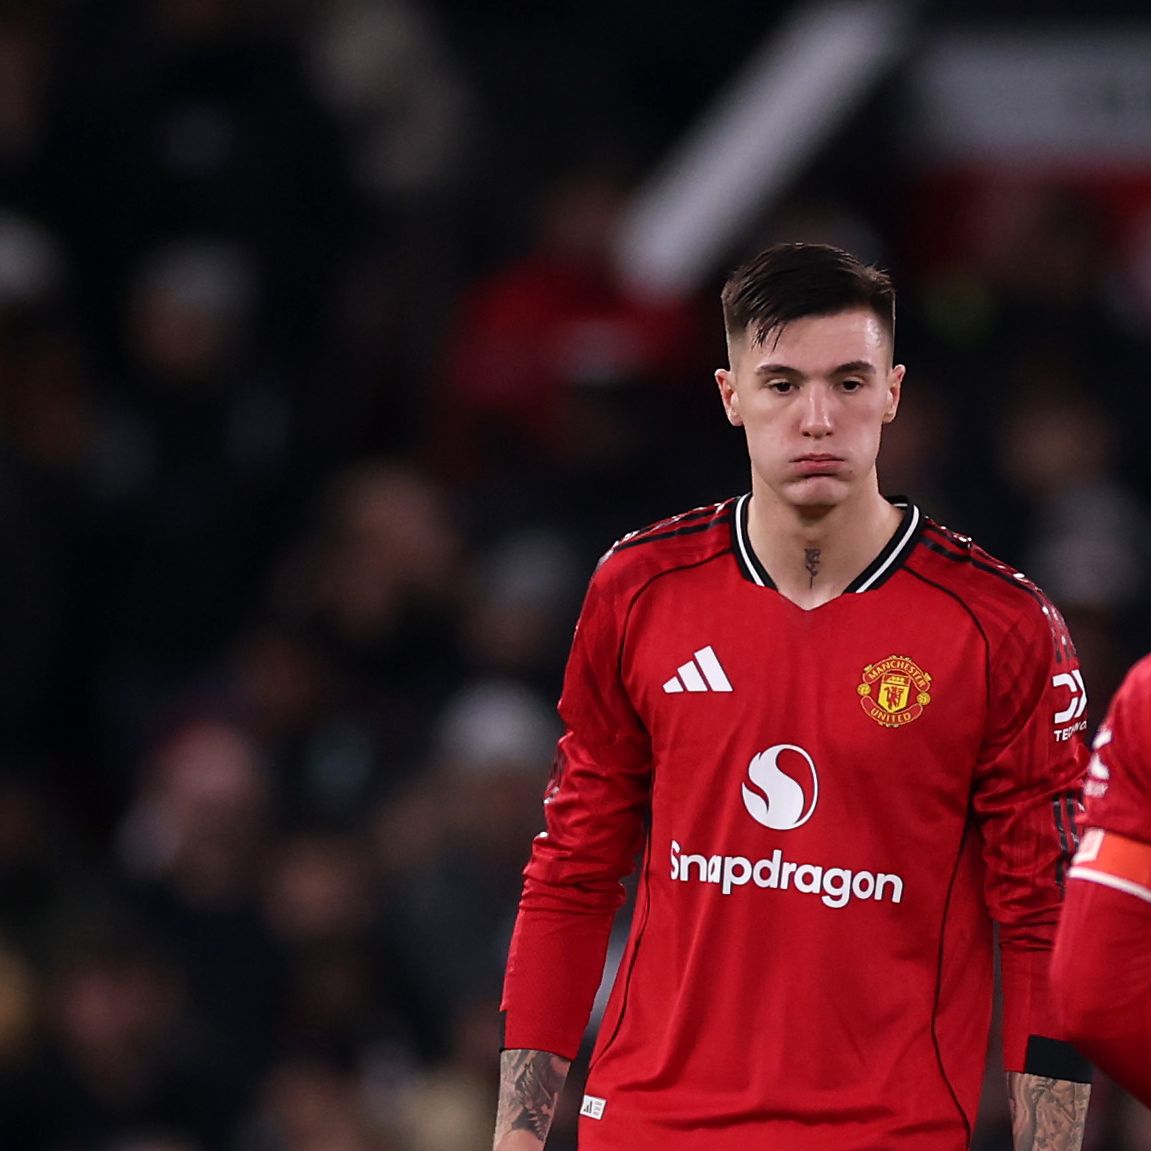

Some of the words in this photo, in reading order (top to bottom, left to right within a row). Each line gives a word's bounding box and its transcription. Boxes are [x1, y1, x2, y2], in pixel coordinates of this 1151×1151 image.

[868, 660, 926, 688] MANCHESTER
[870, 707, 912, 723] UNITED
[670, 840, 904, 909] Snapdragon
